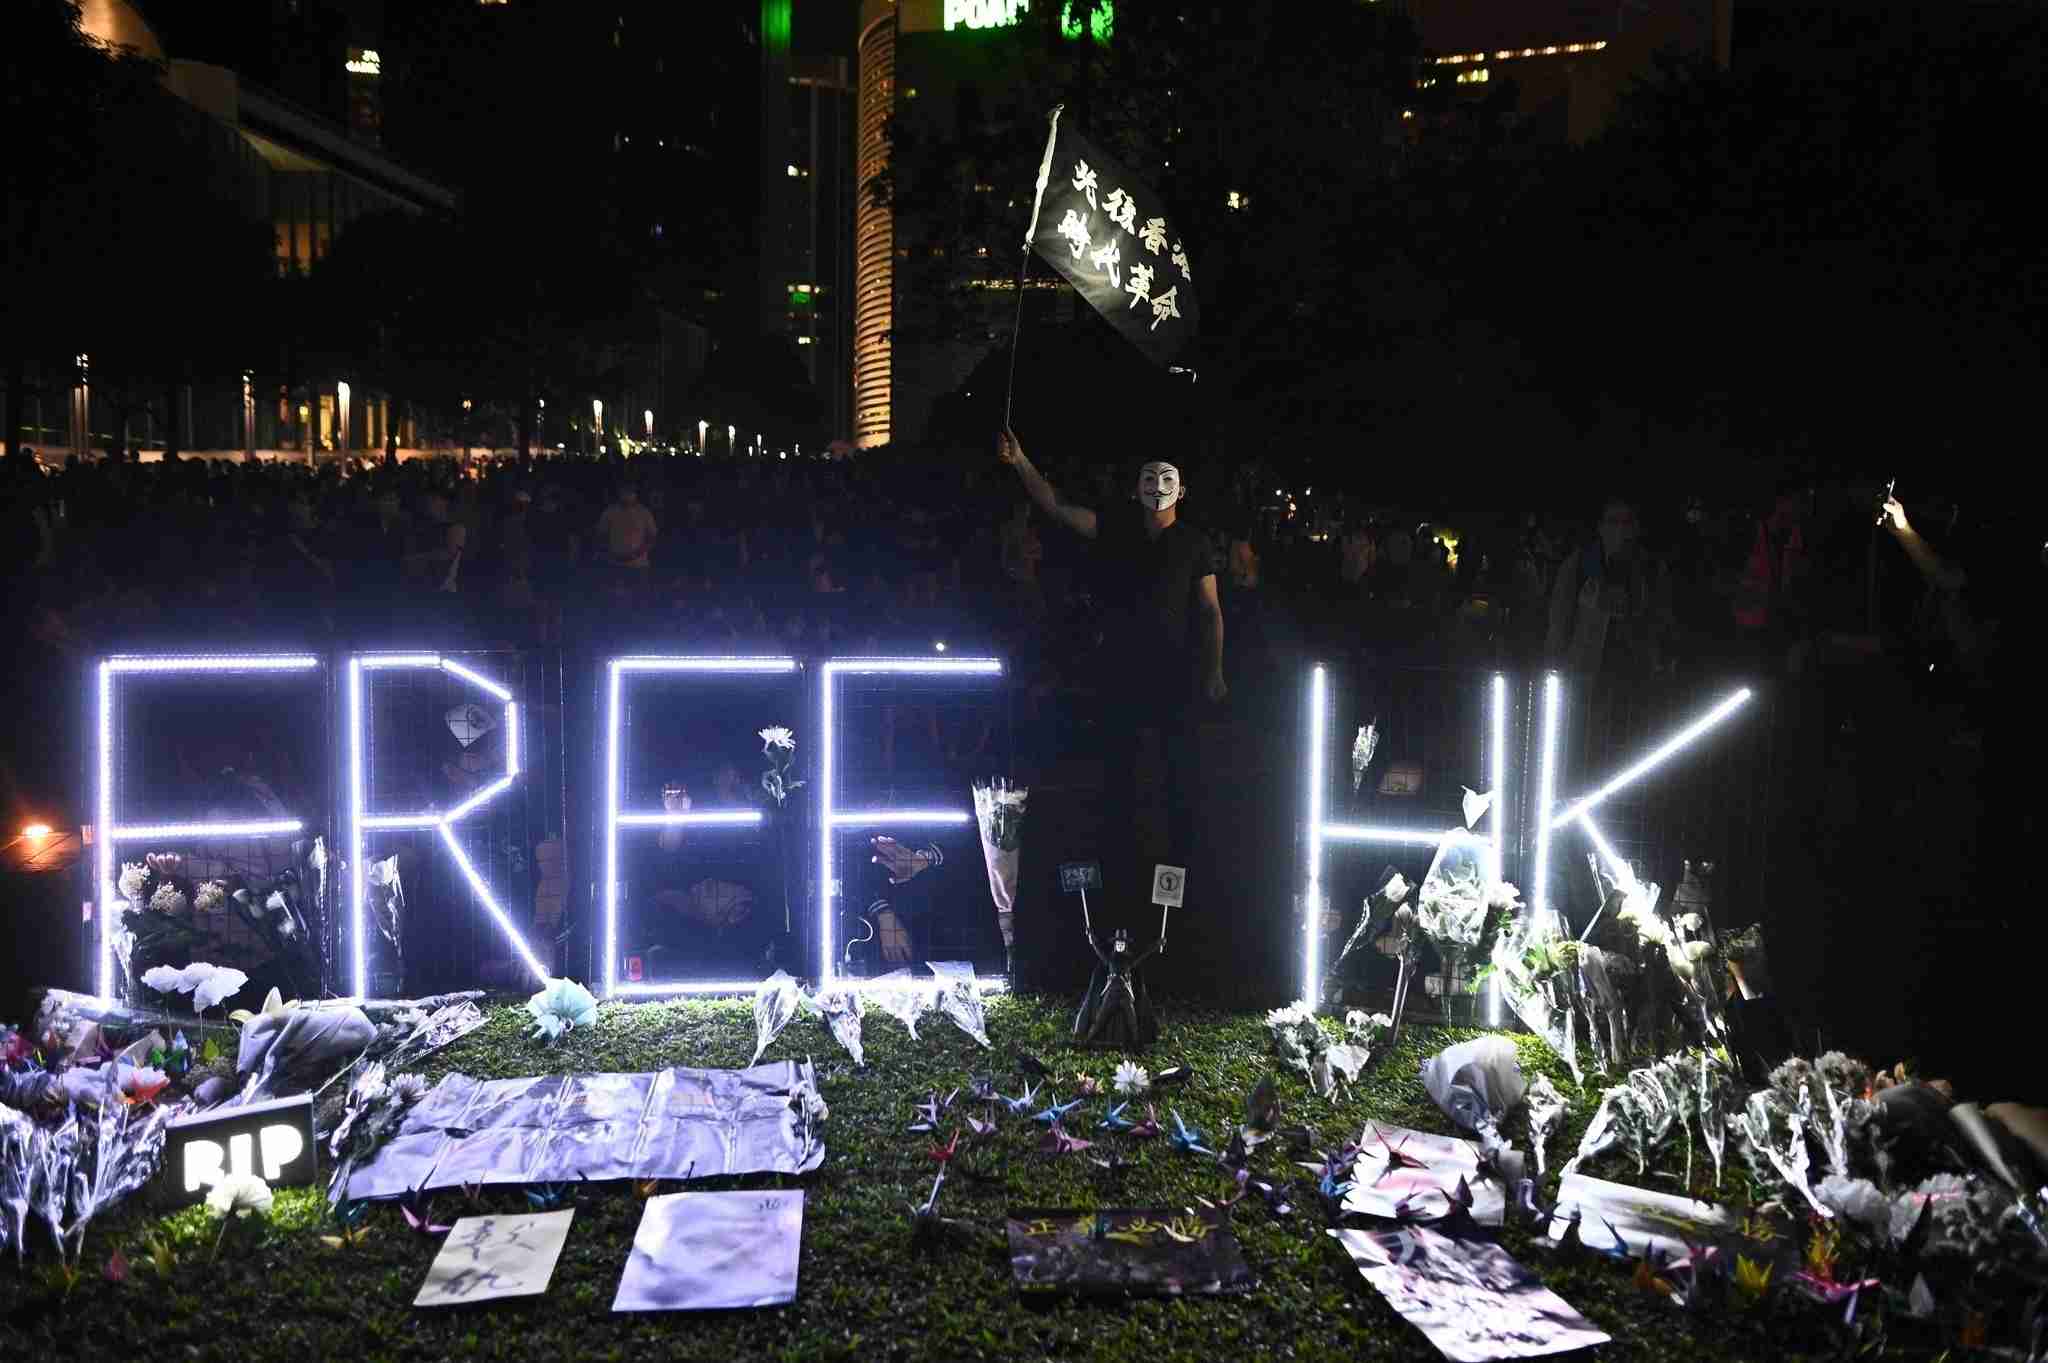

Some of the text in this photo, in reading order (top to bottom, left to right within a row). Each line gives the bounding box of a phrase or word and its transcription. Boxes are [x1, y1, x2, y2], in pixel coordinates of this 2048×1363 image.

[1058, 208, 1182, 330] 時代革命
[97, 649, 1753, 1028] FREE HK
[183, 1124, 303, 1194] RIP
